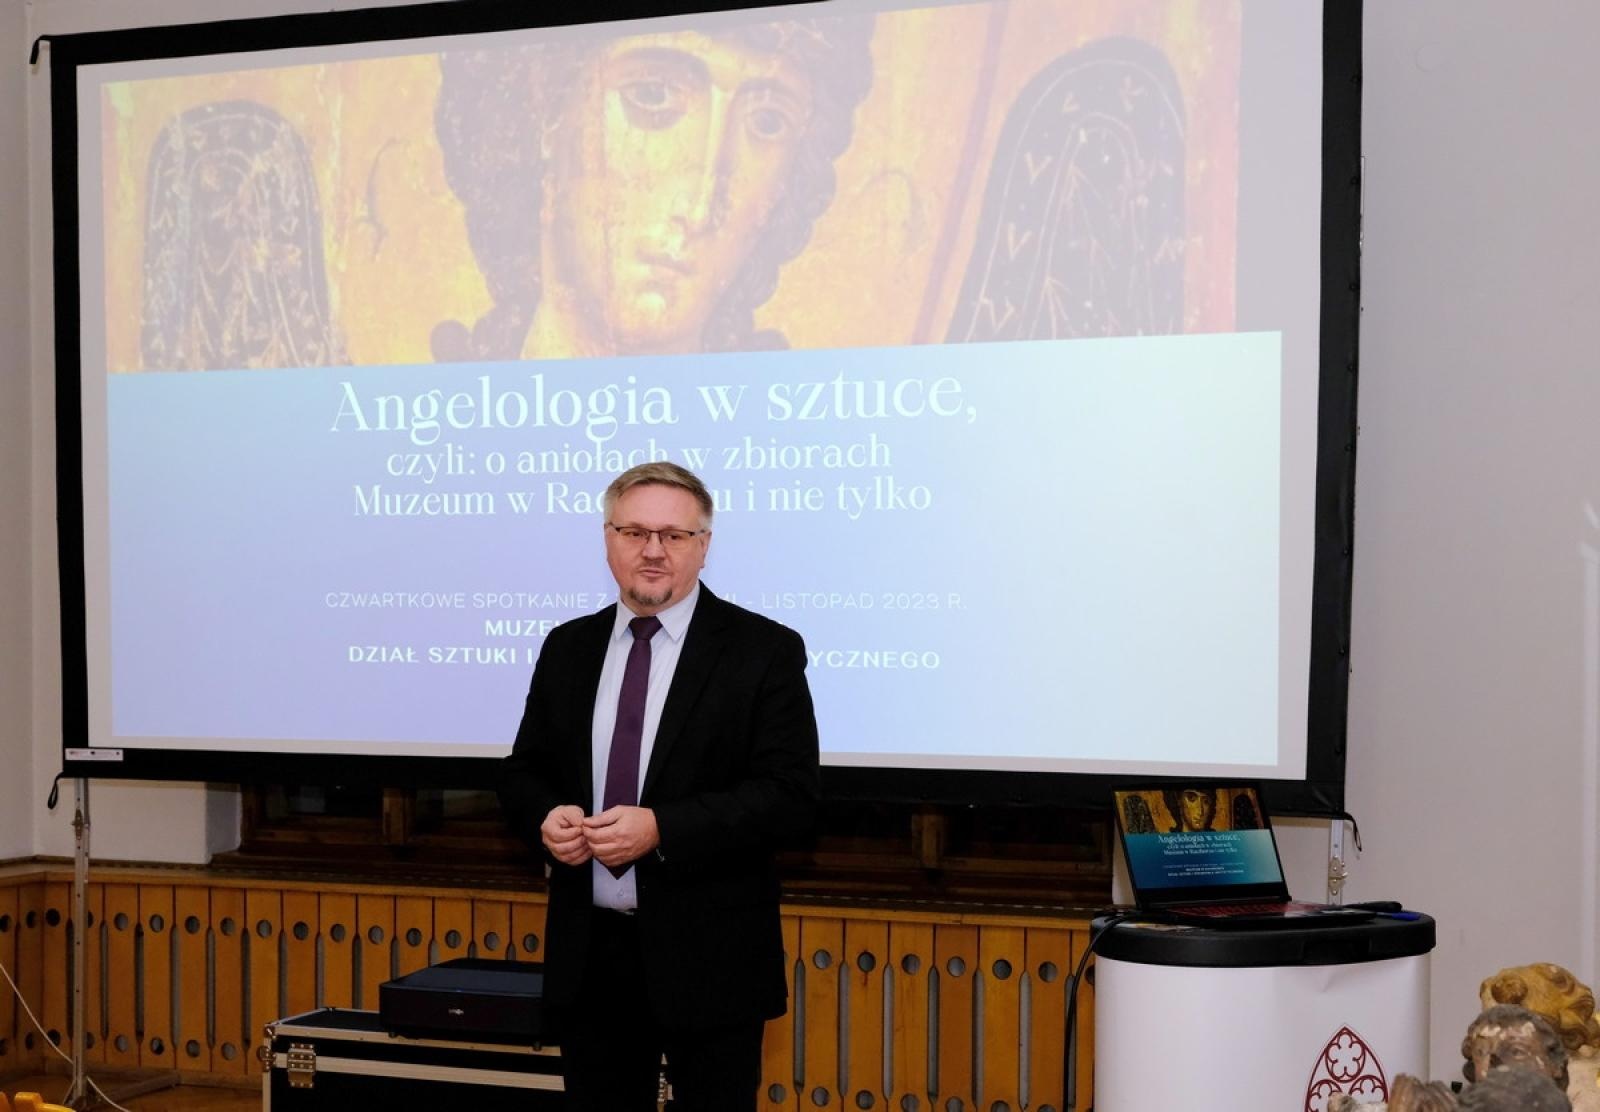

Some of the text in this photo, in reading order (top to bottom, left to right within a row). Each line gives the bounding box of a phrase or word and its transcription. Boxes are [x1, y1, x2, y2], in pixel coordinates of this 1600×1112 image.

[329, 369, 977, 445] Angelologia w sztuce,
[387, 442, 475, 484] czyli:
[486, 453, 505, 475] o
[681, 448, 711, 471] w
[722, 433, 893, 471] zbiorach
[353, 484, 495, 516] Muzeum
[507, 492, 535, 514] w
[746, 481, 757, 512] i
[768, 480, 824, 511] nie
[836, 476, 932, 520] tylko
[325, 592, 466, 609] CZWARTKOWE
[472, 592, 589, 609] SPOTKANIE
[596, 592, 608, 609] Z
[762, 593, 874, 609] LISTOPAD
[883, 593, 940, 609] 2023
[948, 593, 968, 609] R.
[348, 646, 419, 664] DZIAŁ
[428, 647, 516, 665] SZTUKI
[808, 650, 941, 669] YCZNEGO
